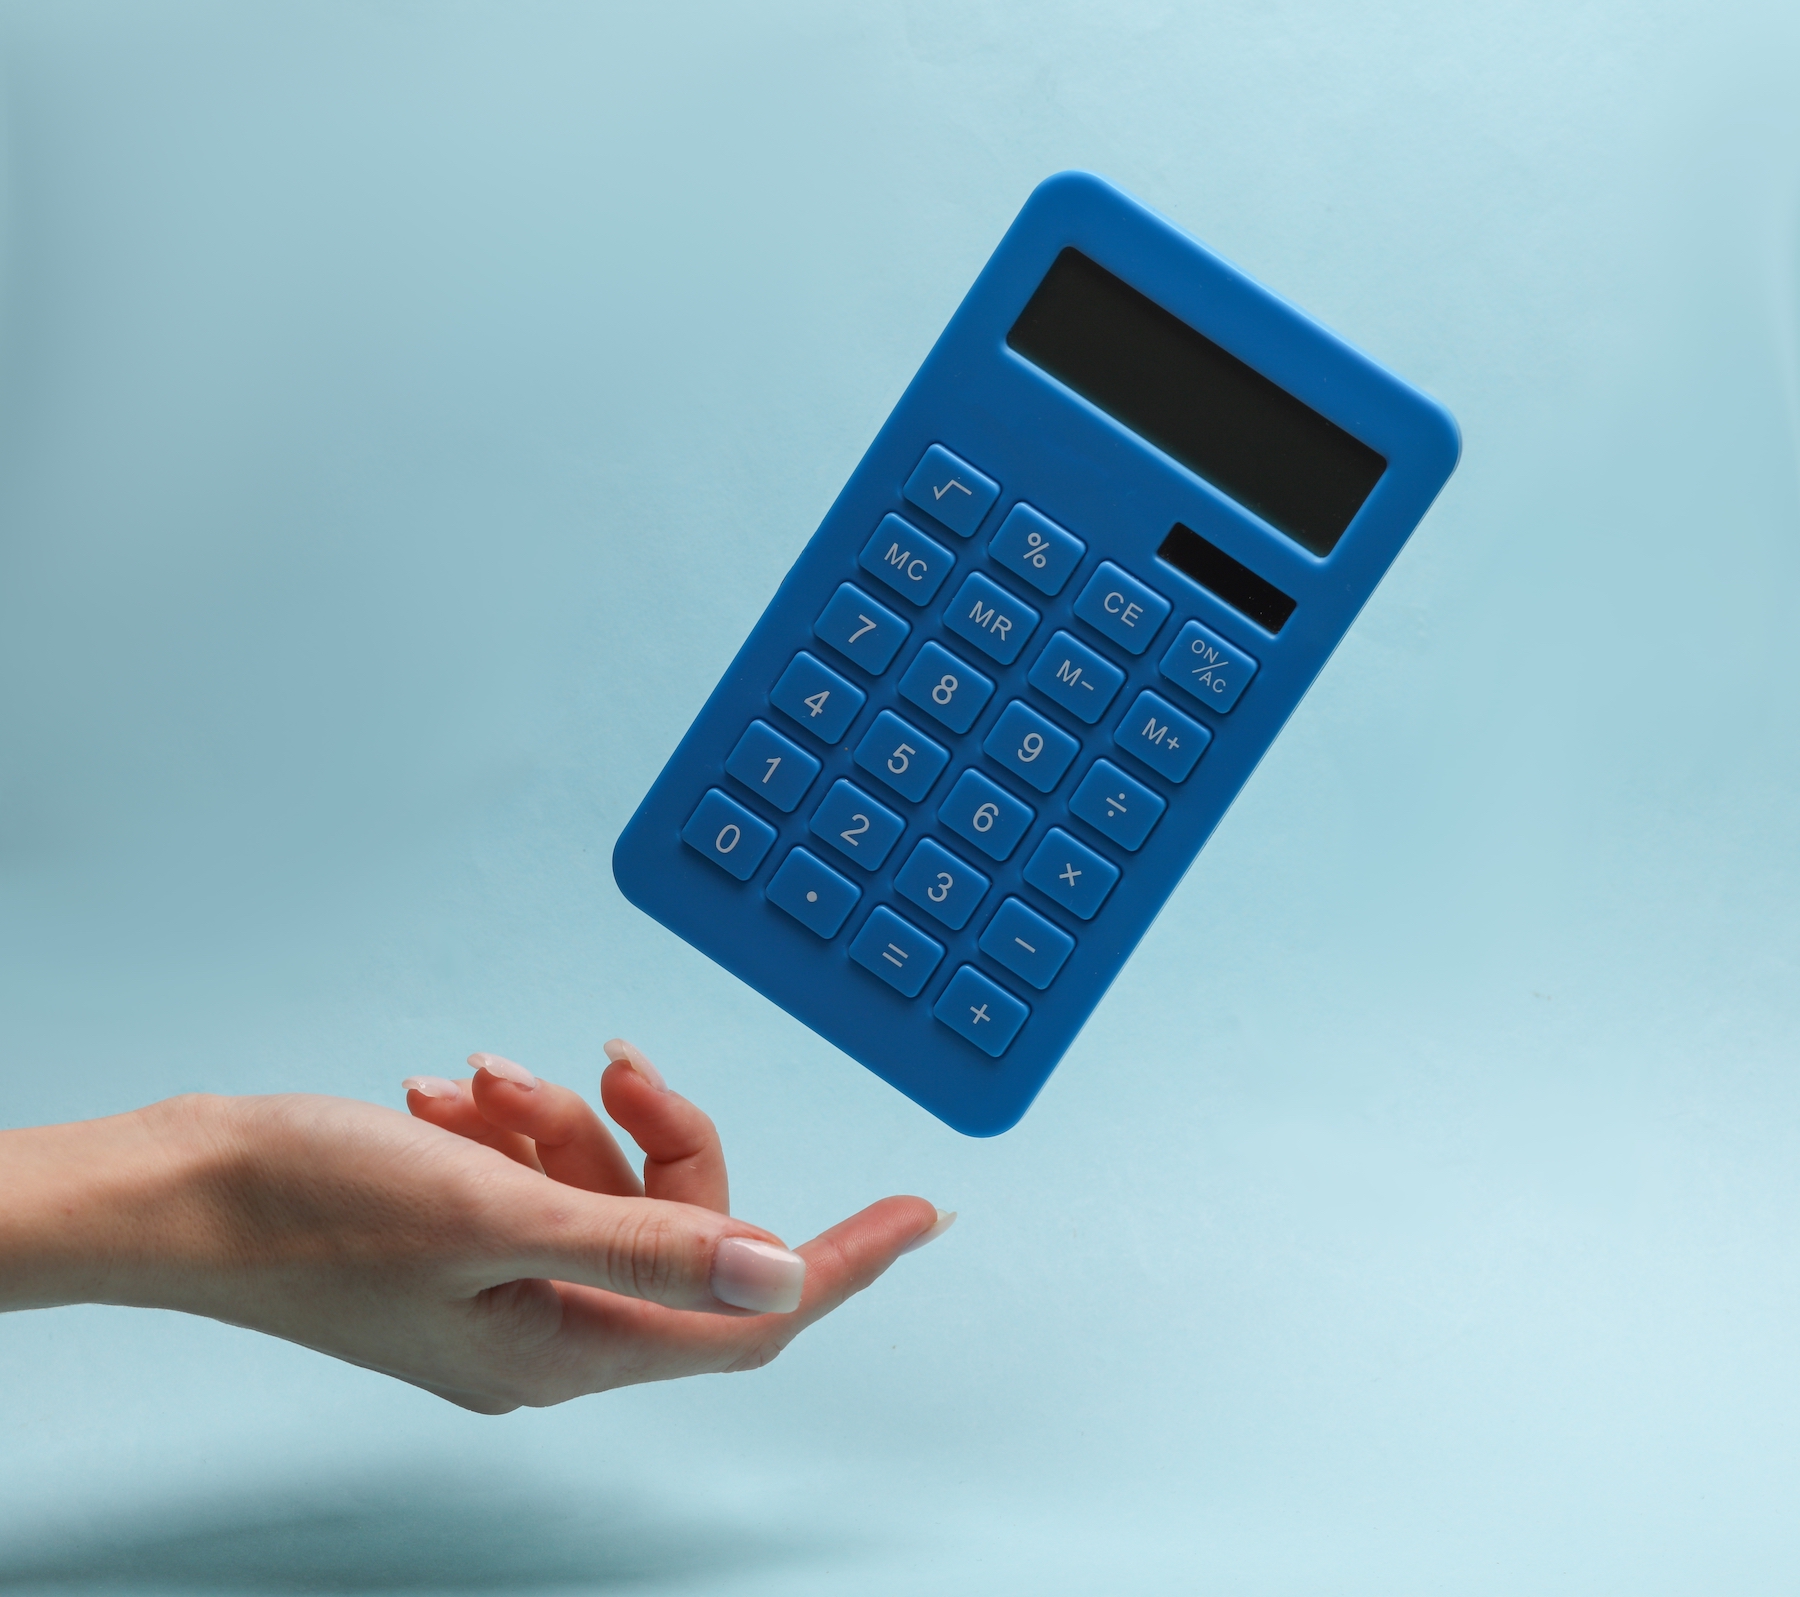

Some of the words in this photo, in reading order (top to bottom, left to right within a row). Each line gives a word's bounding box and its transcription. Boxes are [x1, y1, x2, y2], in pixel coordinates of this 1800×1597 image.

[883, 542, 928, 582] MC
[1024, 532, 1049, 569] %
[968, 600, 1013, 641] MR
[1103, 591, 1144, 628] CE
[848, 614, 877, 644] 7
[803, 690, 831, 718] 4
[931, 674, 959, 705] 8
[1017, 732, 1044, 763] 9
[1141, 717, 1180, 751] M+
[762, 757, 782, 784] 1
[887, 743, 916, 774] 5
[840, 813, 870, 847] 2
[972, 802, 999, 833] 6
[715, 824, 741, 854] 0
[927, 872, 954, 902] 3
[882, 943, 909, 968] =
[969, 1003, 991, 1025] +
